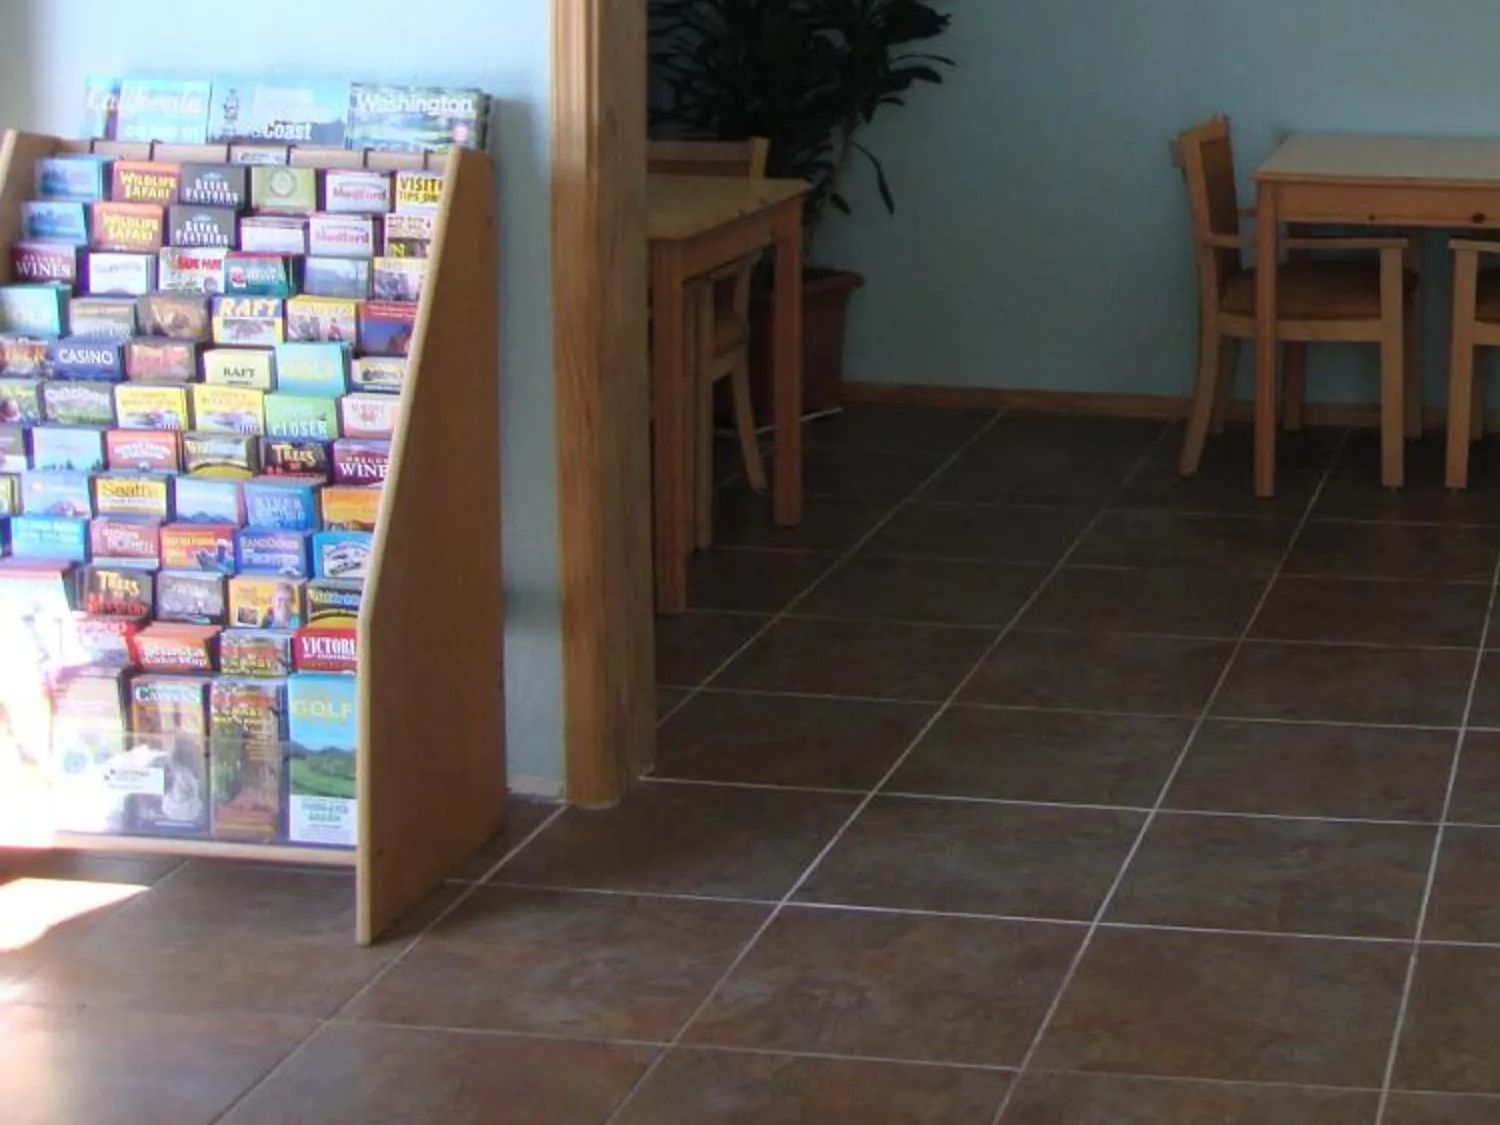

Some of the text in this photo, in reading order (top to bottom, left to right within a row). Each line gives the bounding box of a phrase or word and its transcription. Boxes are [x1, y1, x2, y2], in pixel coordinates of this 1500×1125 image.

[356, 92, 473, 117] Washington
[15, 260, 73, 278] WINES
[219, 297, 277, 318] RAFT
[58, 348, 114, 366] CASINO
[223, 366, 256, 377] RAFT
[339, 462, 390, 478] WINE
